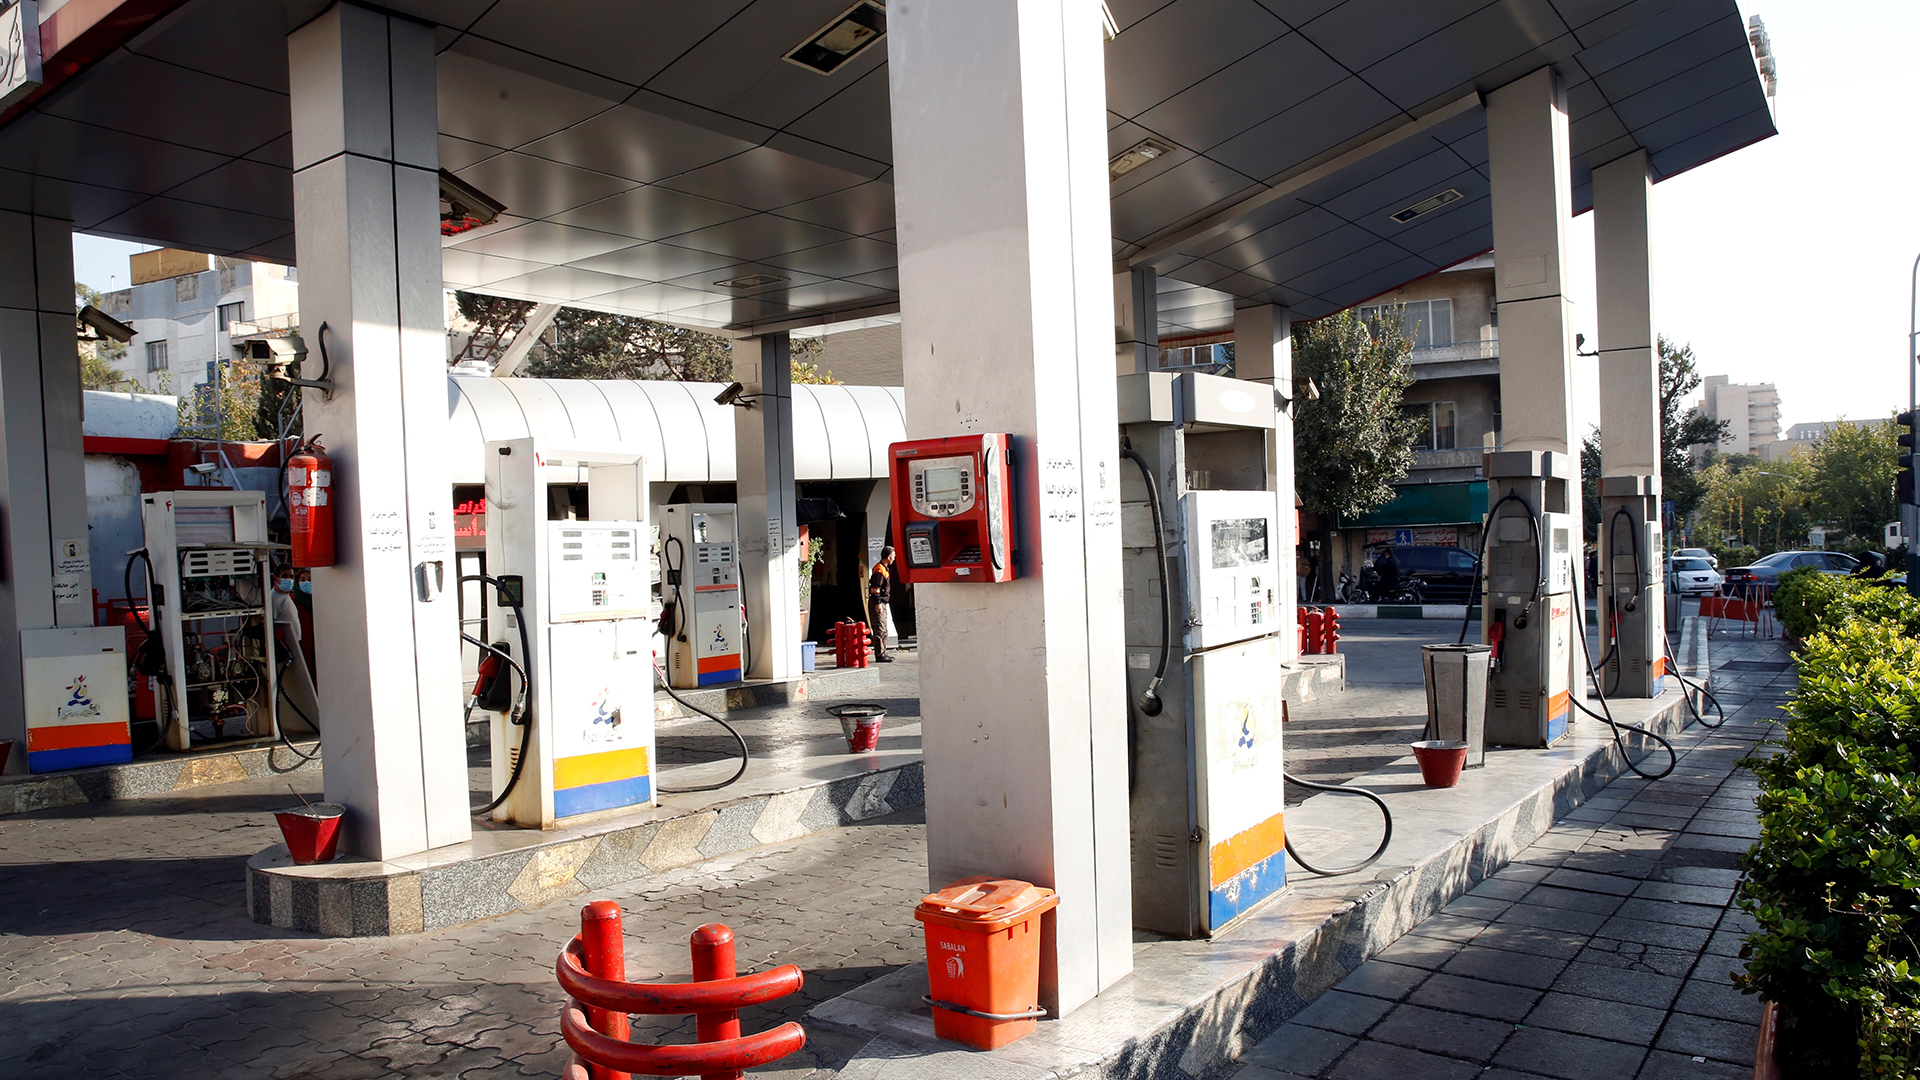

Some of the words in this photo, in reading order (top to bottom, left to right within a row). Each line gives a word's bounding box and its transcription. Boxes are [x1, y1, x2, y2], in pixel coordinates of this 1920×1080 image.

[1066, 484, 1077, 498] داخل
[1065, 510, 1077, 522] ممنوع
[389, 543, 401, 552] ممنوع
[940, 941, 966, 952] SABALAN
